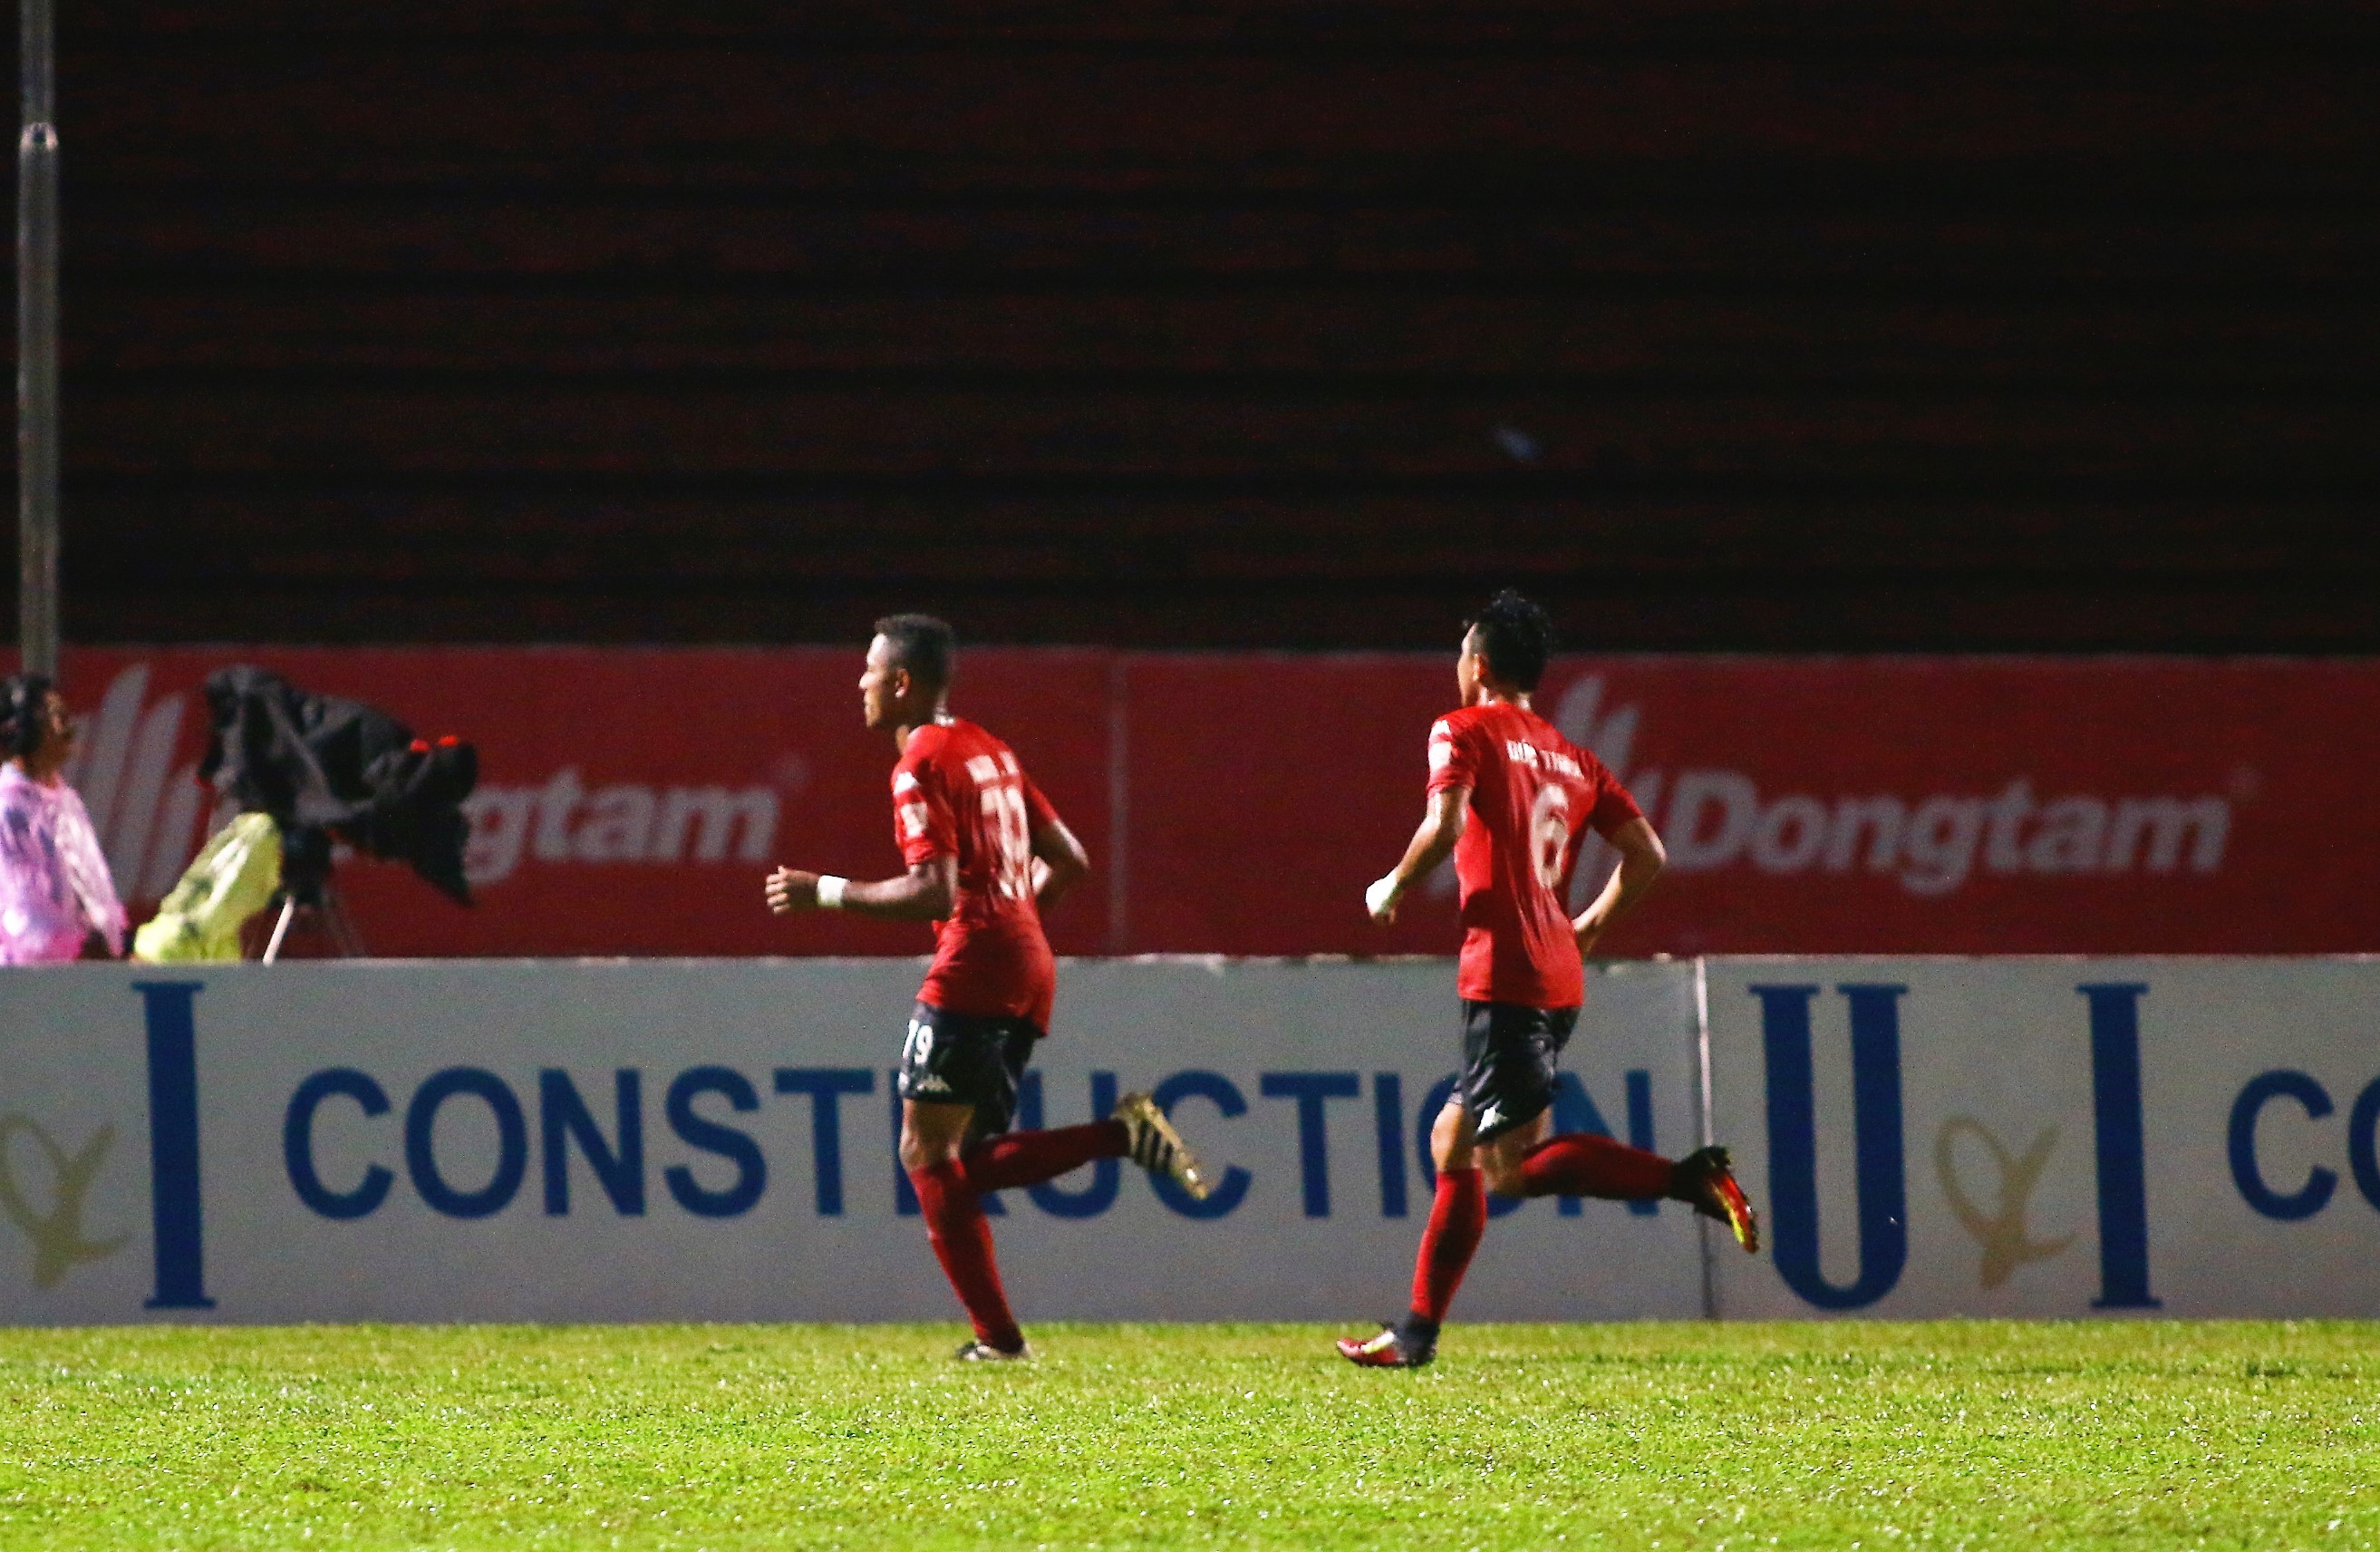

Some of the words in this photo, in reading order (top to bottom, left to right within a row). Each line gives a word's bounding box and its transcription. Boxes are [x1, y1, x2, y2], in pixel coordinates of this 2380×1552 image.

[459, 765, 779, 884] gtam
[1529, 783, 1570, 890] 6
[1666, 768, 2232, 897] Dongtam
[282, 1064, 1661, 1219] CONSTUCTIN
[2227, 1068, 2380, 1221] C
